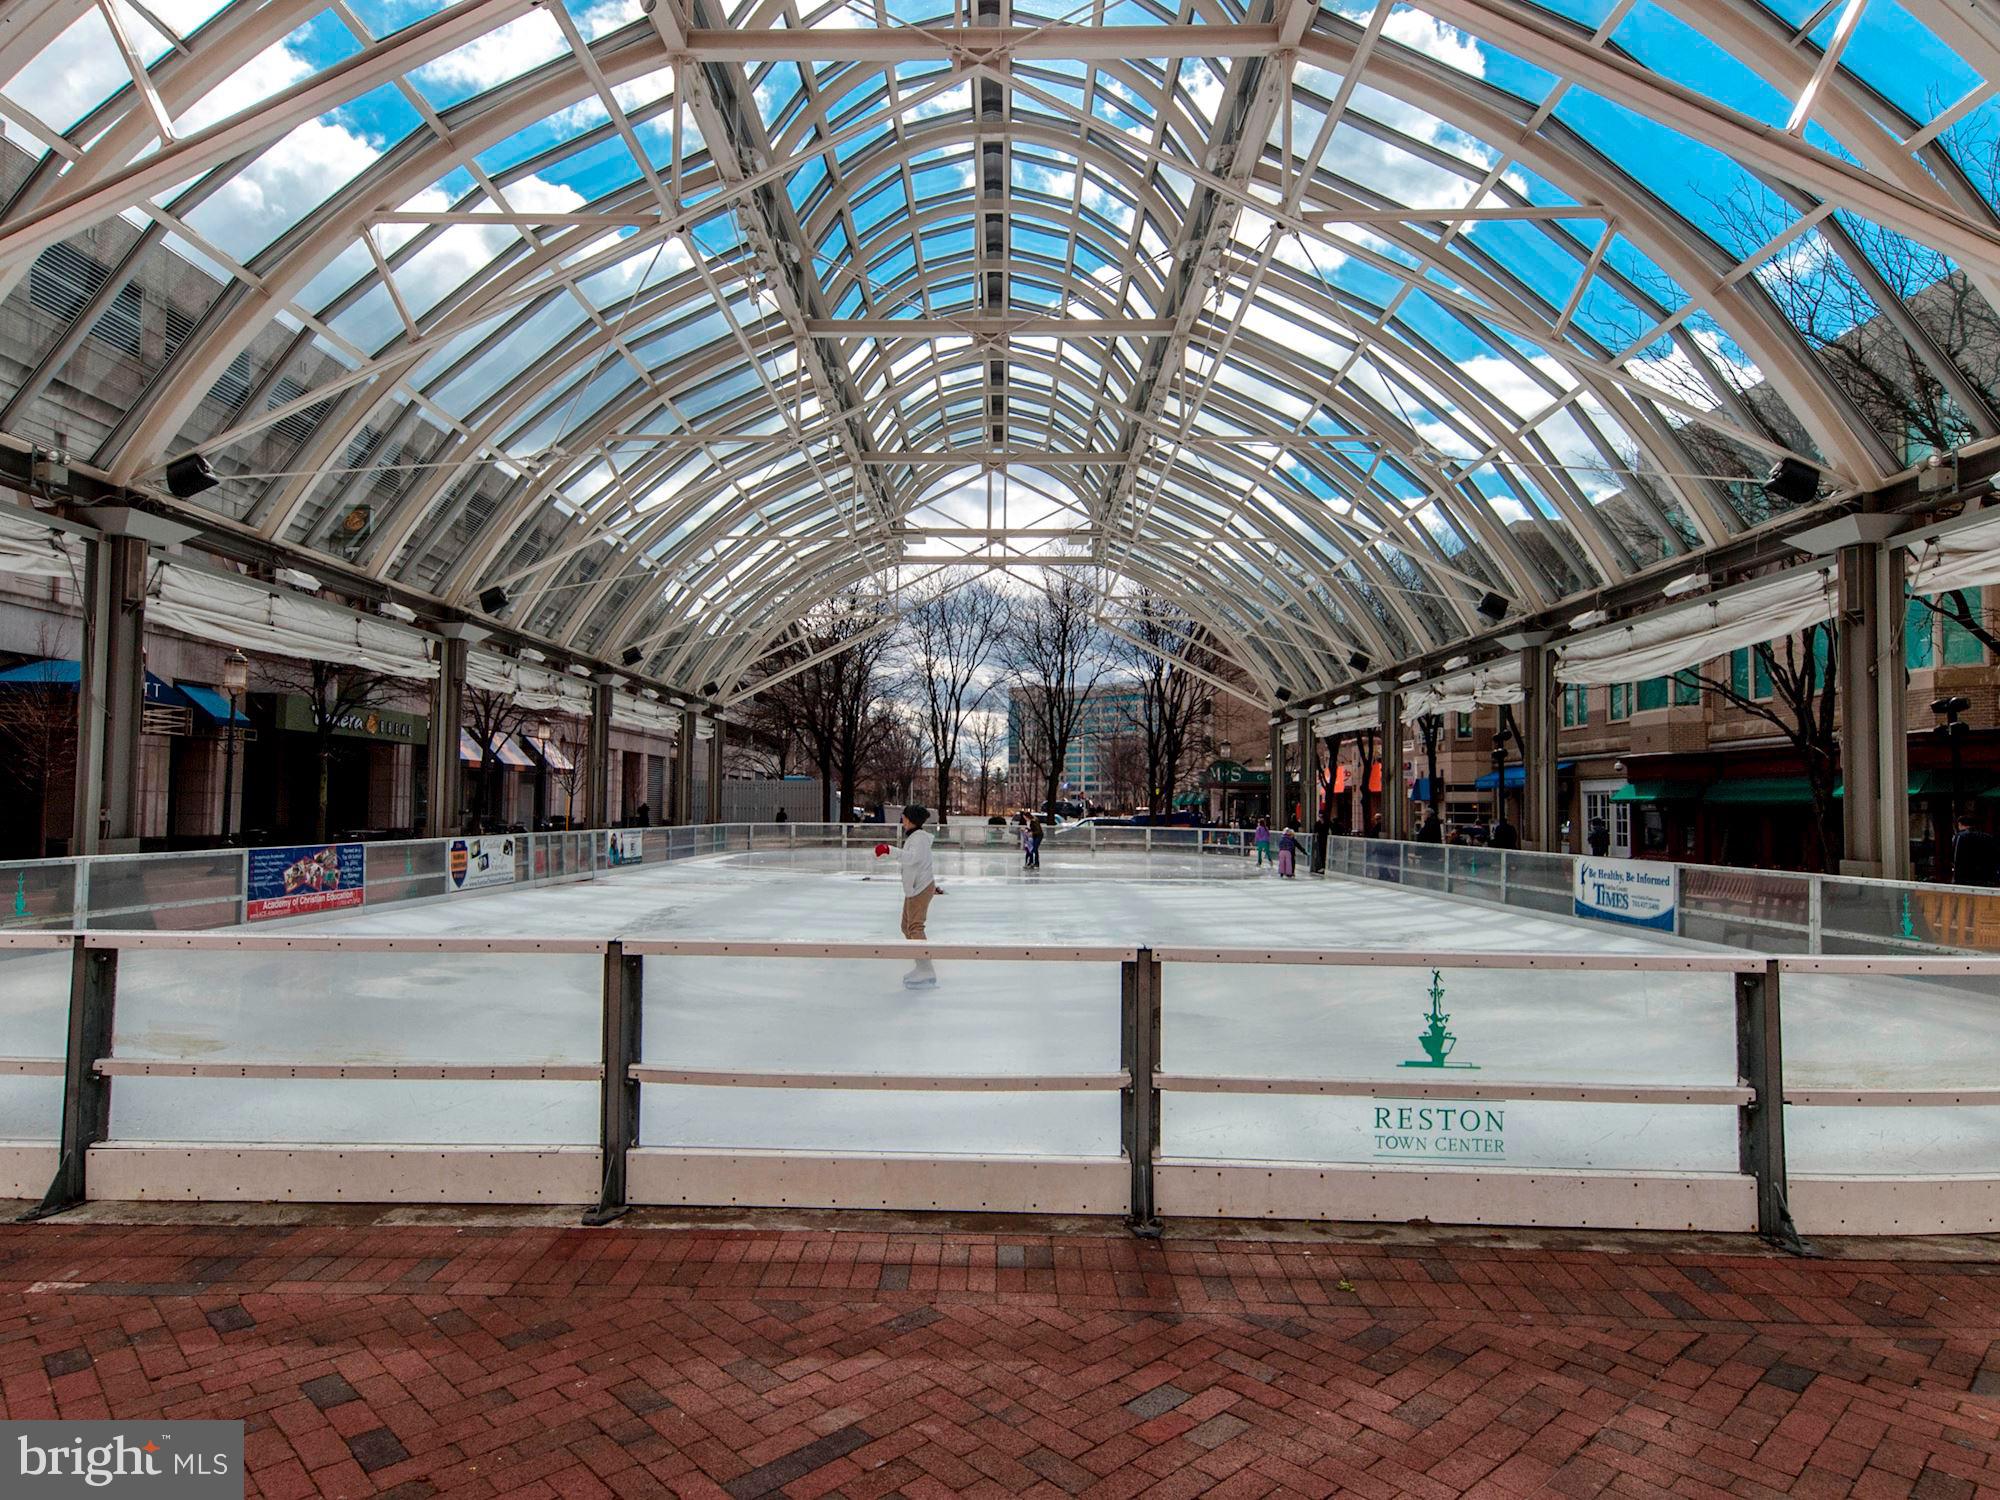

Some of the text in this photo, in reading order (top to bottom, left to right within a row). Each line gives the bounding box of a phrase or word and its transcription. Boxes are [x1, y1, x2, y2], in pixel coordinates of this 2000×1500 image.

[1588, 868, 1670, 886] Be Healthy, Be Informed
[262, 899, 292, 910] Academy
[292, 897, 299, 905] of
[299, 895, 326, 905] Christian
[326, 891, 353, 902] Education
[1593, 882, 1629, 910] TIMES
[1374, 1107, 1505, 1132] RESTON
[1374, 1135, 1504, 1153] TOWN CENTER
